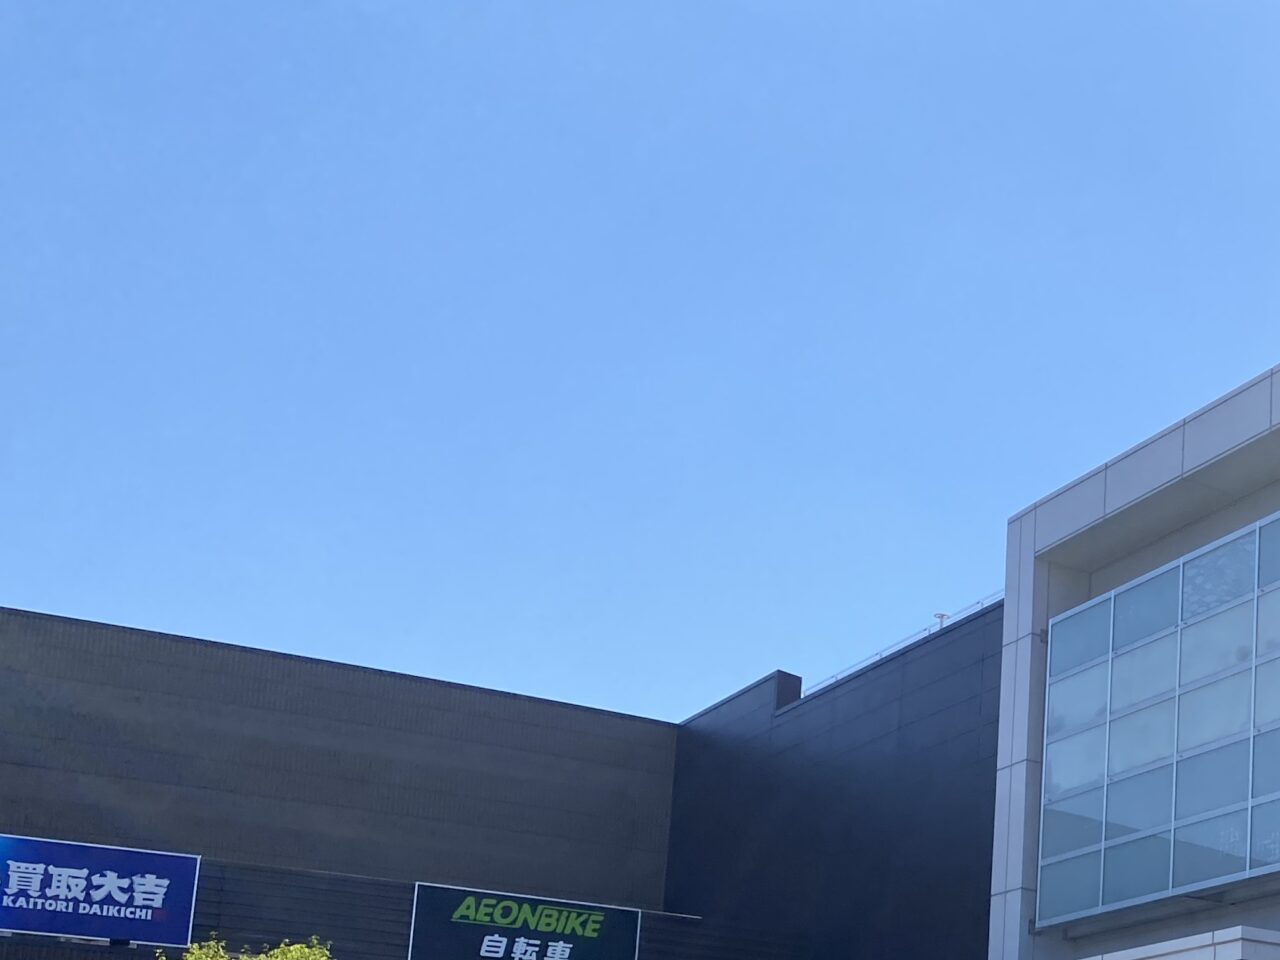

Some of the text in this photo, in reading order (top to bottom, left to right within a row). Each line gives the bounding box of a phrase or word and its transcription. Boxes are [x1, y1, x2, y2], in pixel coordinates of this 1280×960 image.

[4, 859, 171, 908] 買取大吉
[2, 895, 153, 921] KAITORI DAIKICHI
[451, 895, 605, 938] AEONBIKE
